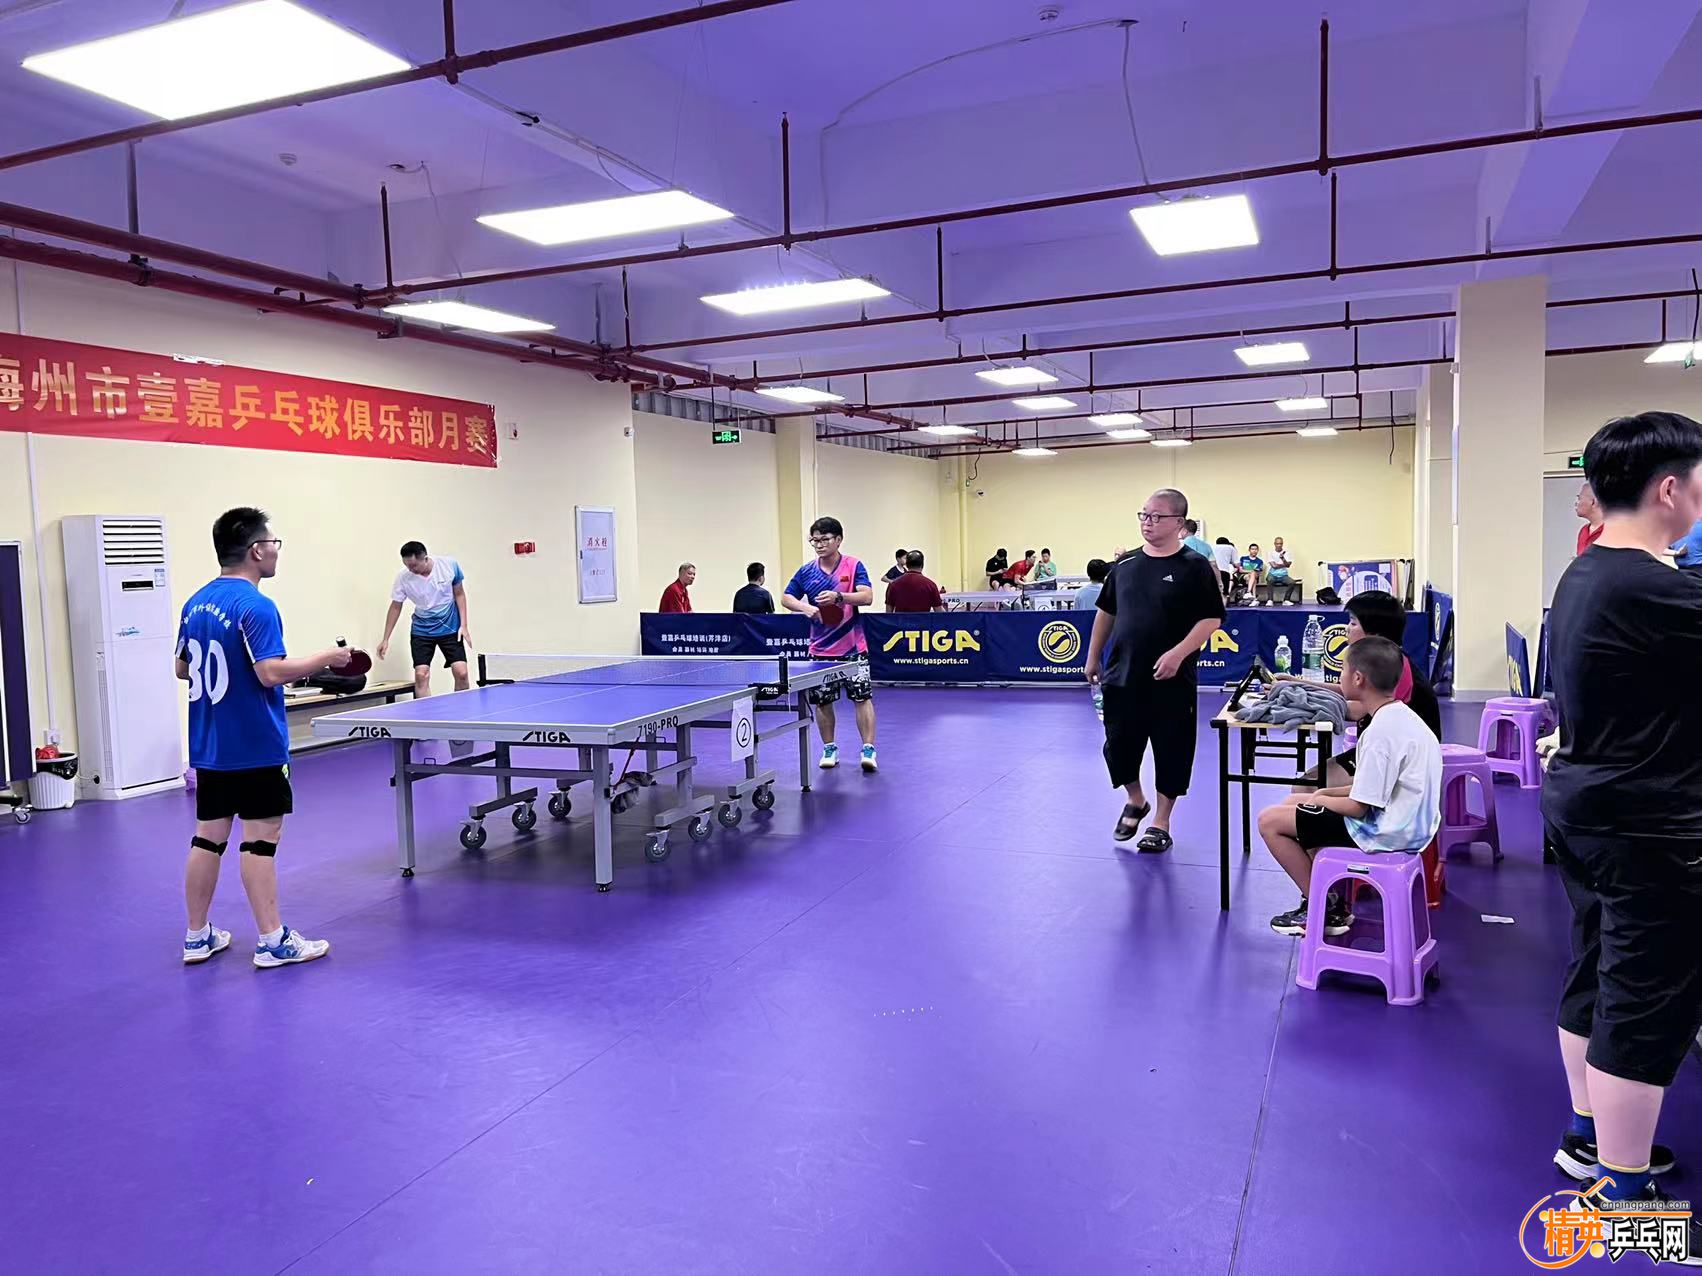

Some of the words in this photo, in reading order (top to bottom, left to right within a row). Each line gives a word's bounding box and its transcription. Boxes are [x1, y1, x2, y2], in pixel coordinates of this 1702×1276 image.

[882, 630, 980, 652] STIGA
[893, 657, 969, 665] www.stigasports.cn
[1019, 665, 1085, 674] www.stigasport
[348, 726, 391, 737] STIGA
[522, 731, 571, 742] STIGA
